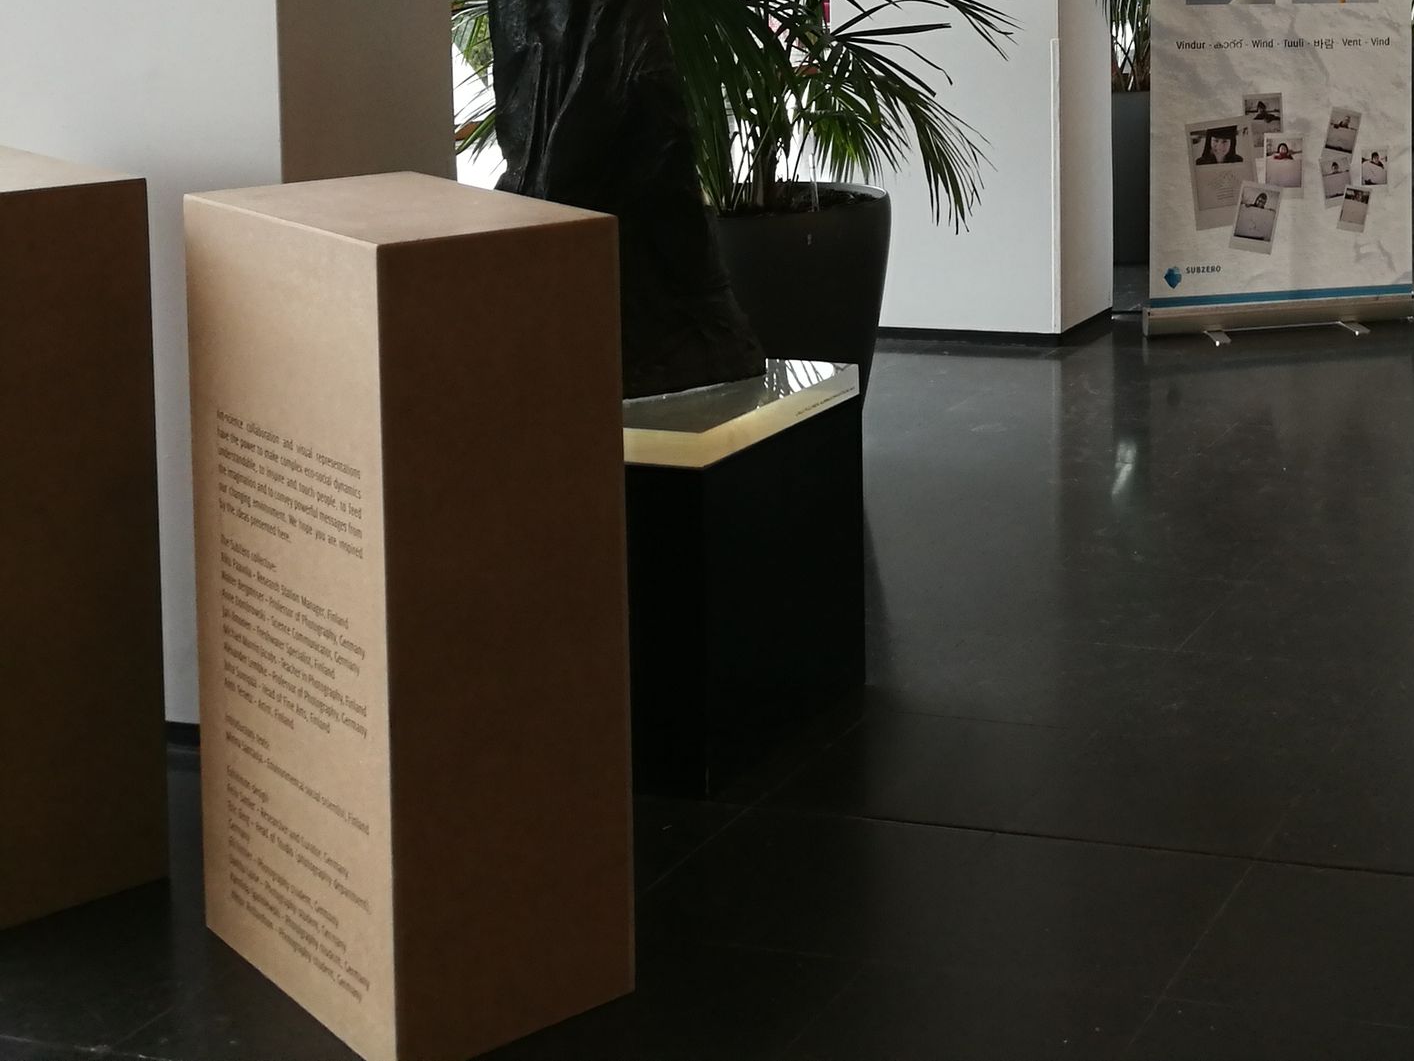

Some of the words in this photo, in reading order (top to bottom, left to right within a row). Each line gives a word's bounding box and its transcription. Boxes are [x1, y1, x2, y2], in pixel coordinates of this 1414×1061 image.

[1176, 40, 1206, 50] Vindur
[1251, 39, 1274, 48] Wind
[1313, 38, 1334, 49] 바람
[1342, 38, 1361, 46] Vent
[1370, 37, 1390, 46] Vind
[1186, 265, 1221, 274] SUBZERO
